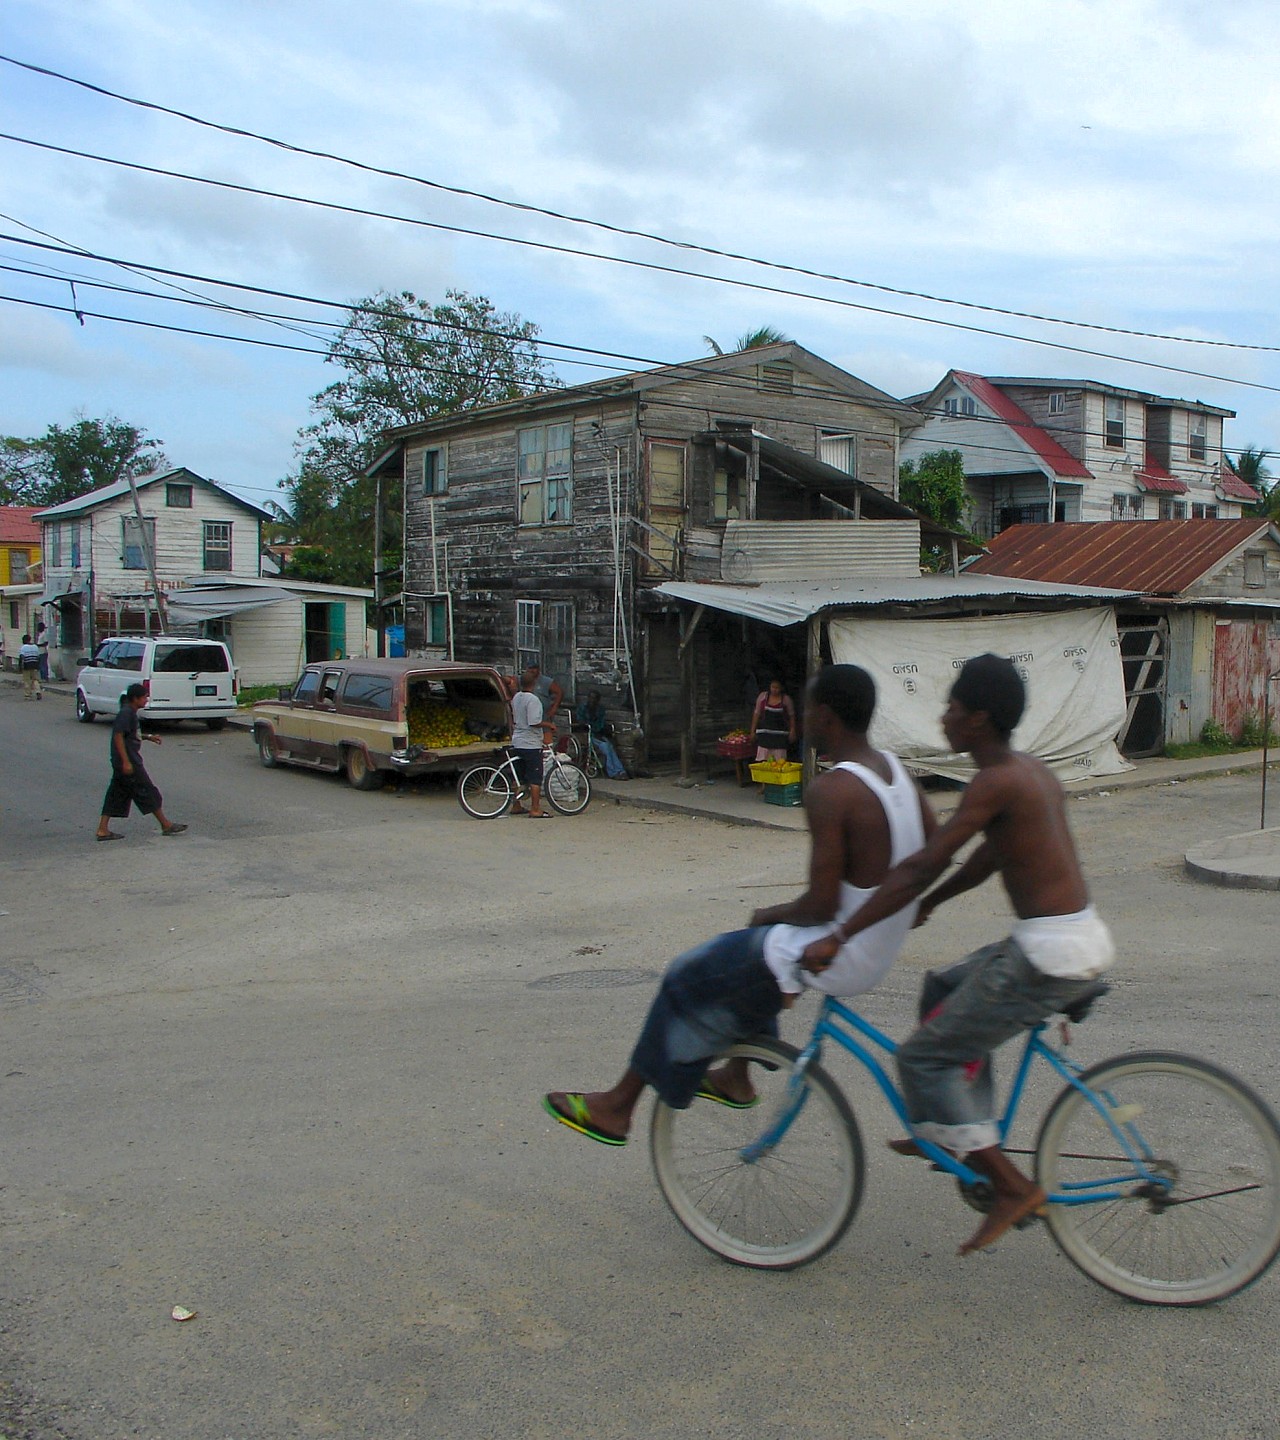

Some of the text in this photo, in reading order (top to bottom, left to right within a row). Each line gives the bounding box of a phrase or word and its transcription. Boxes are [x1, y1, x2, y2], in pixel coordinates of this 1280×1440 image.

[1063, 647, 1088, 658] USAID
[1010, 653, 1034, 663] USAID
[892, 664, 918, 674] USAID
